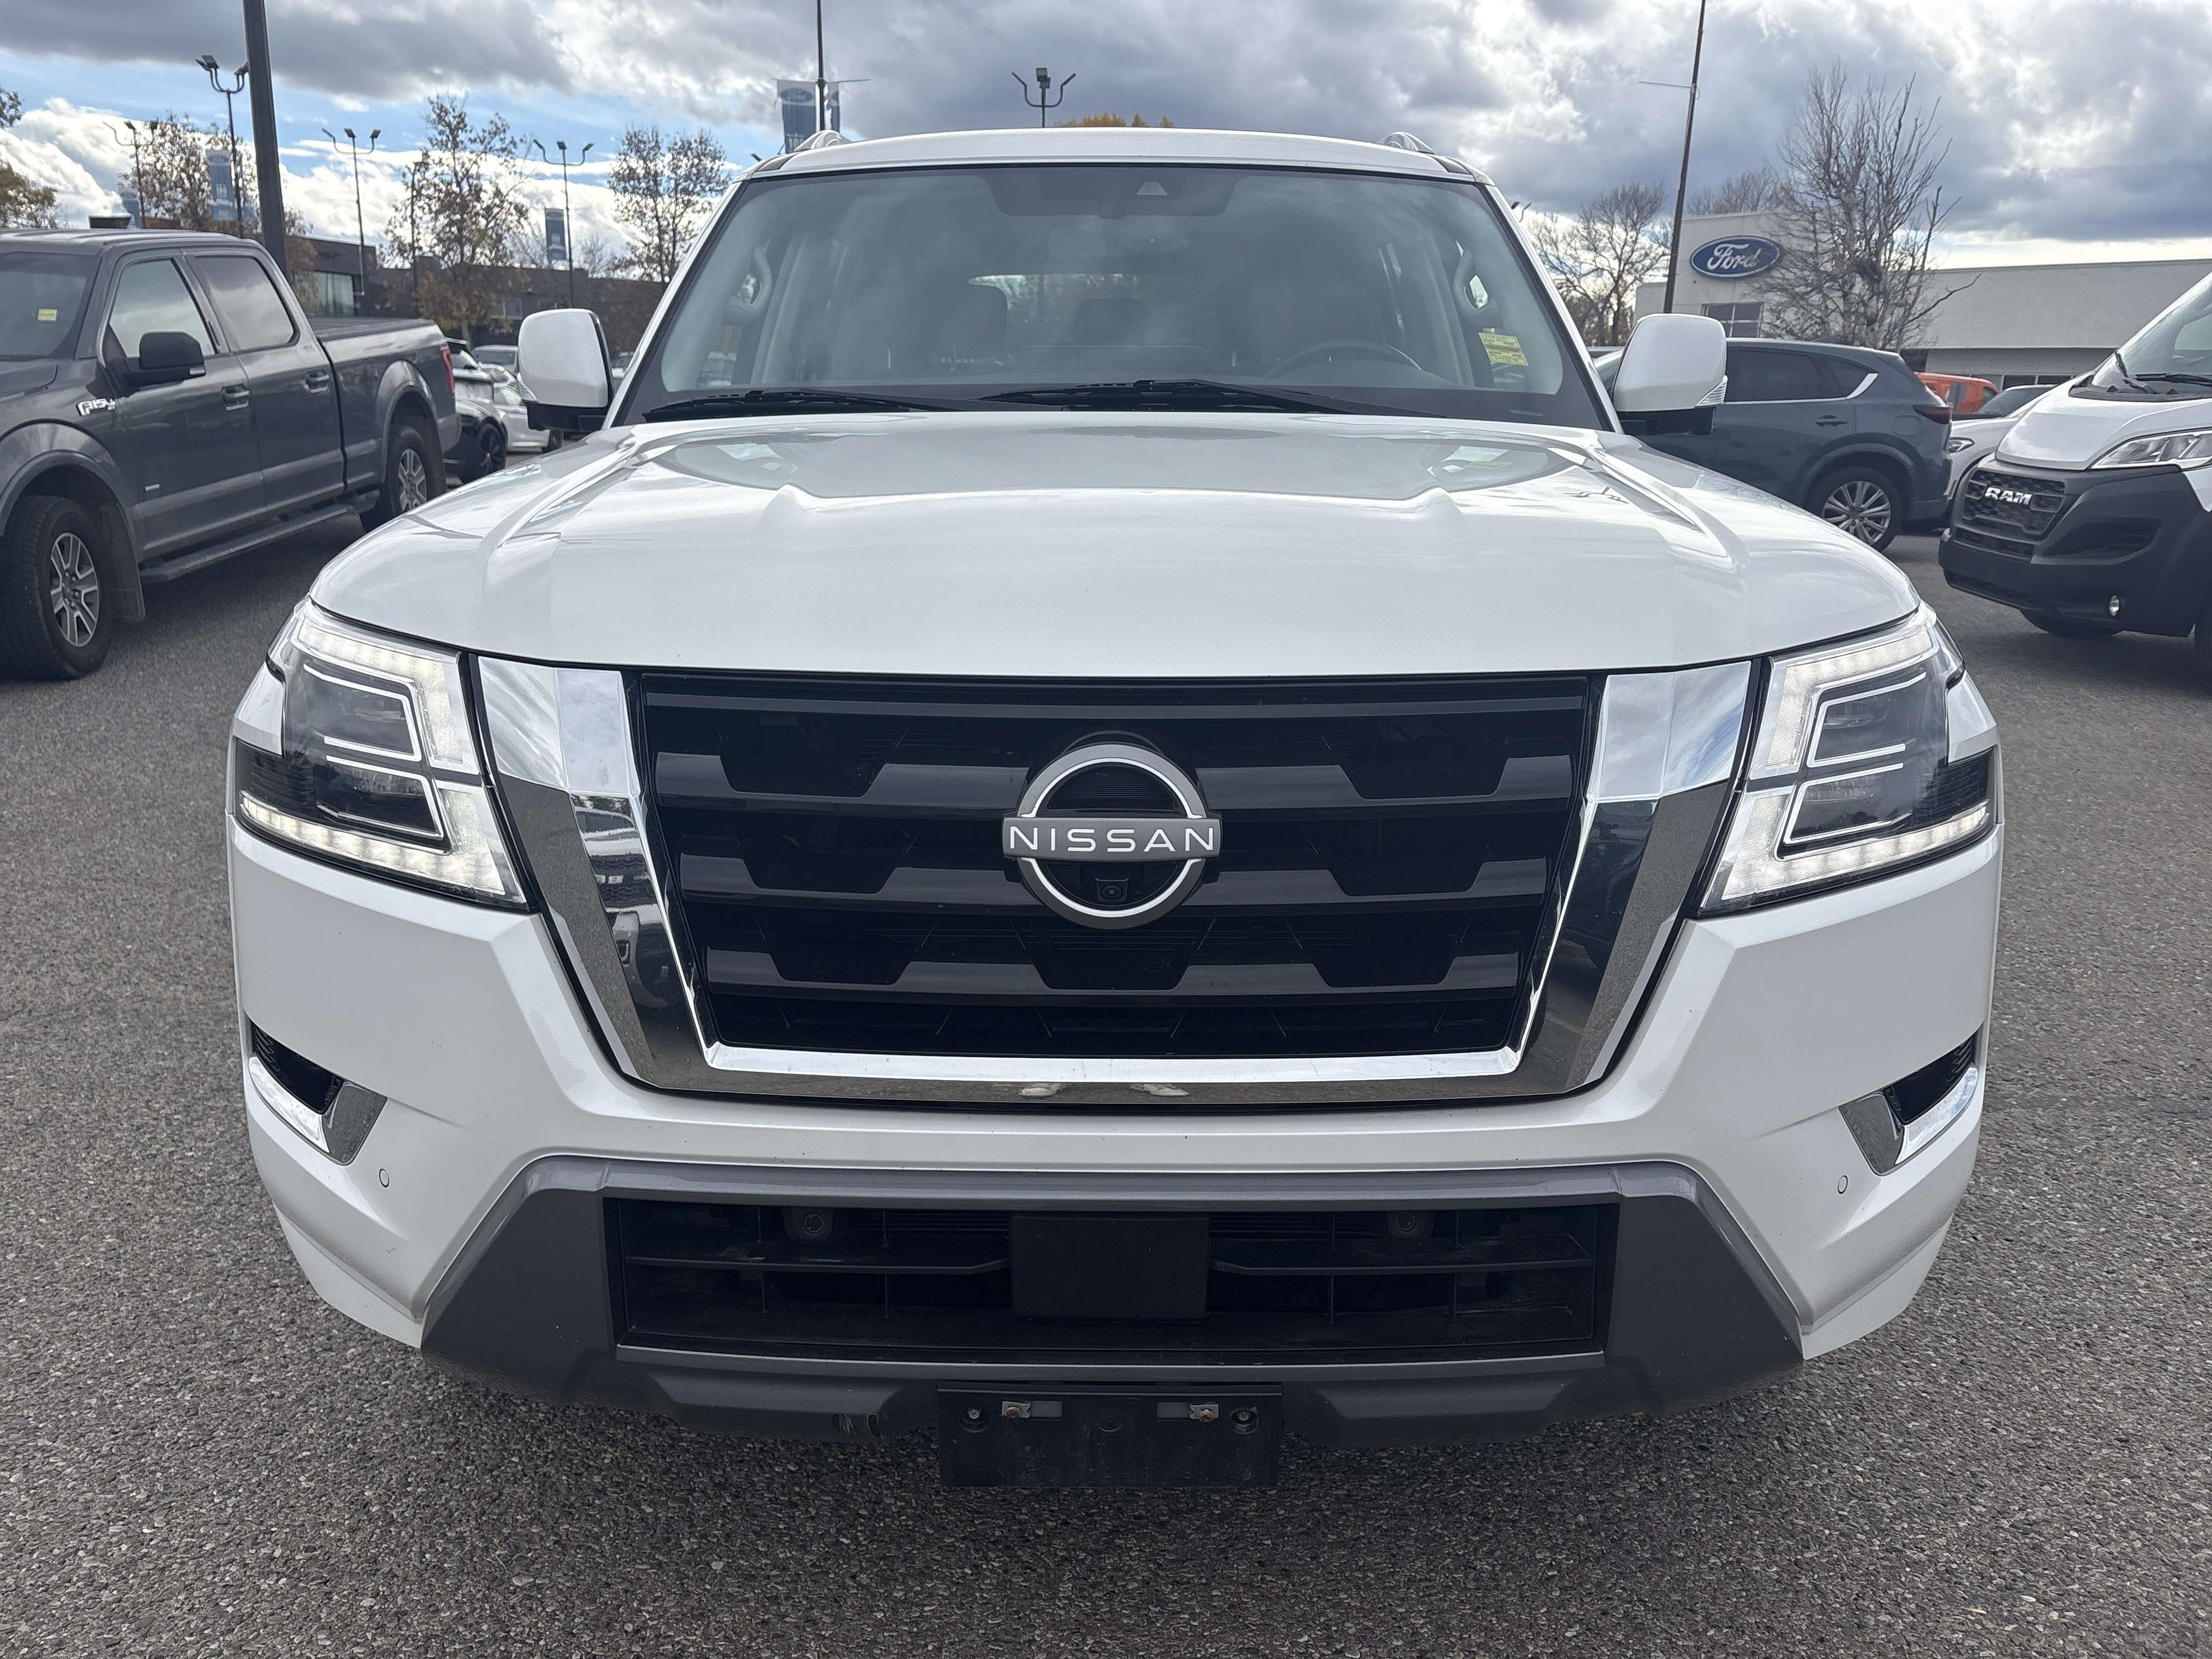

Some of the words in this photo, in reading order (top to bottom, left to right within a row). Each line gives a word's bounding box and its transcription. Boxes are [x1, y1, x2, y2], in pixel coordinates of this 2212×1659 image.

[1707, 243, 1763, 270] Ford
[1984, 487, 2033, 505] RAM
[1009, 826, 1214, 853] NISSAN
